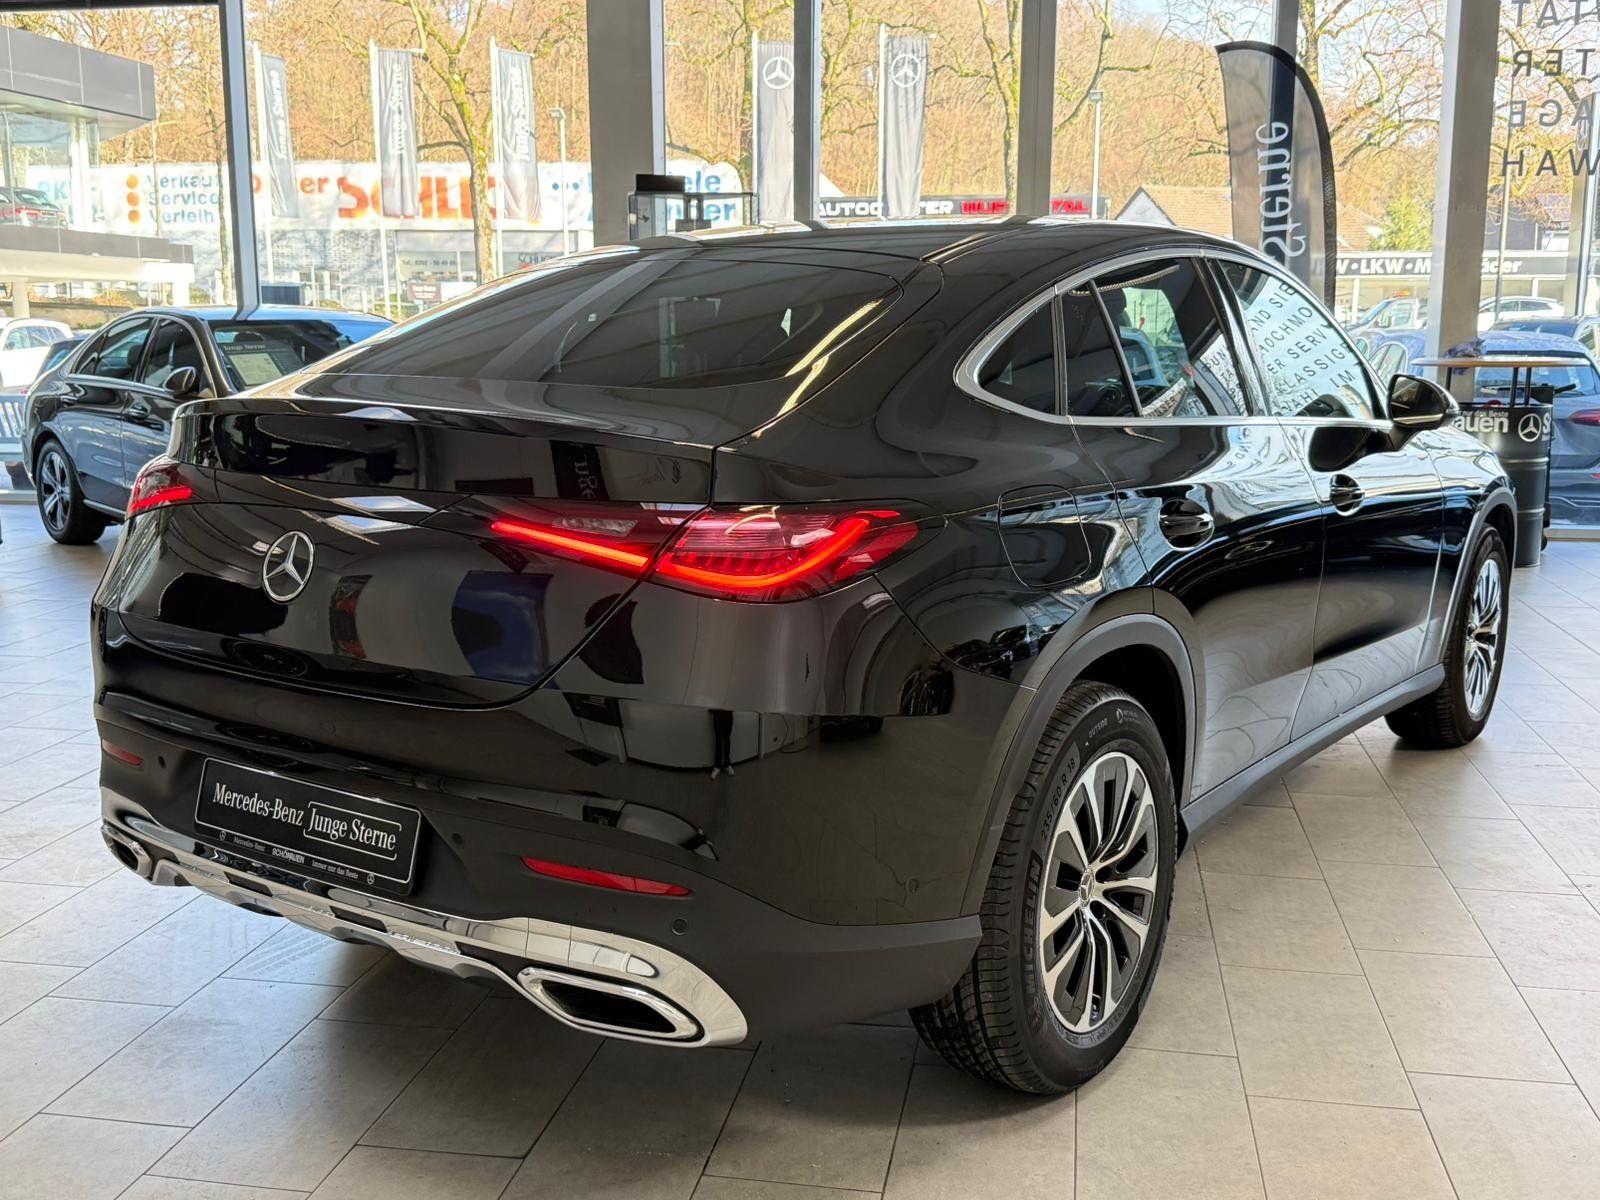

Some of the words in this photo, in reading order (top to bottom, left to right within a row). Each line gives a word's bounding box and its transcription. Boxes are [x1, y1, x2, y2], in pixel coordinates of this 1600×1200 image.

[1360, 258, 1403, 274] LKW
[213, 782, 304, 827] Mercedes-Benz
[307, 807, 348, 841] Junge
[349, 818, 397, 851] Sterne
[1040, 782, 1062, 842] 235/60
[1061, 774, 1068, 787] R
[1066, 757, 1076, 773] 18
